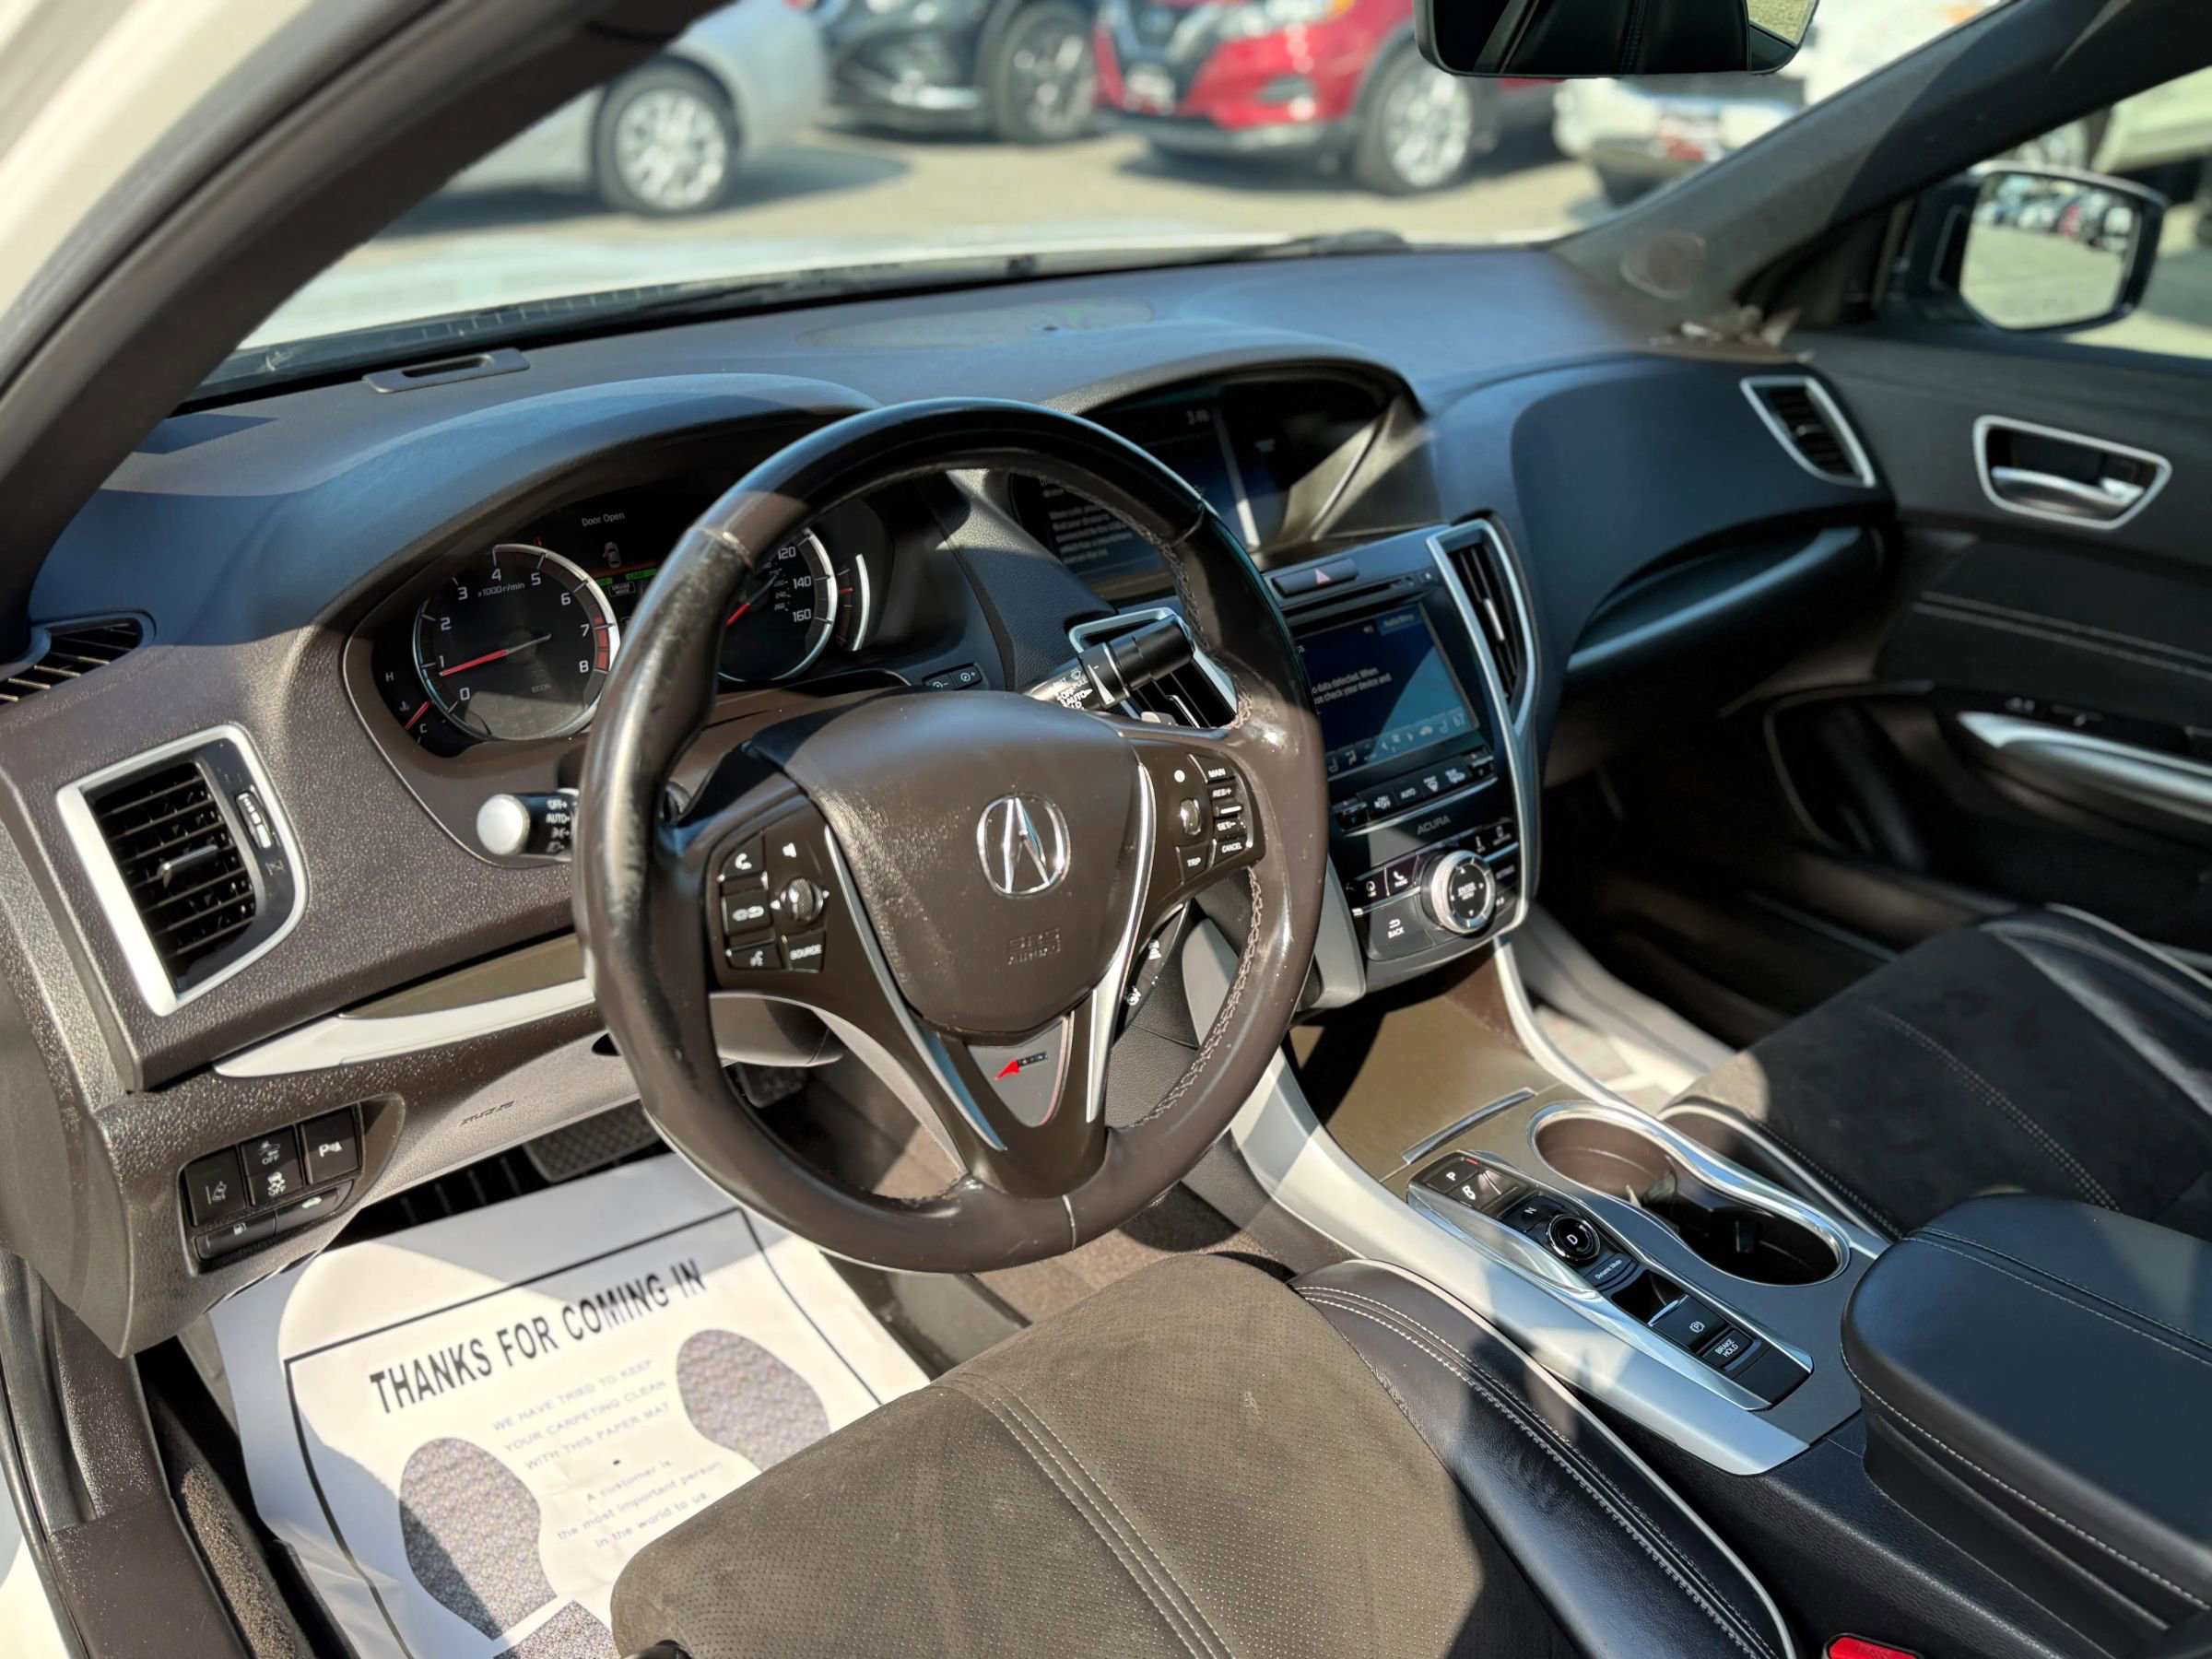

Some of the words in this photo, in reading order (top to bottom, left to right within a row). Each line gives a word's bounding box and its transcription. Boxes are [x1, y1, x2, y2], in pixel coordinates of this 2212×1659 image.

[582, 517, 601, 526] Door
[603, 512, 625, 523] Open
[778, 546, 796, 560] 120
[491, 568, 501, 581] 4
[531, 572, 541, 585] 5
[793, 575, 811, 589] 140
[457, 586, 467, 600] 3
[560, 593, 571, 606] 6
[793, 608, 812, 623] 160
[440, 617, 452, 630] 2
[580, 623, 590, 637] 7
[439, 655, 444, 668] 1
[579, 660, 588, 673] 8
[385, 671, 394, 682] H
[459, 687, 470, 700] 0
[1066, 691, 1087, 706] AUTO
[419, 724, 428, 734] C
[1207, 768, 1227, 778] MAIN
[1400, 787, 1416, 800] AUTO
[547, 798, 562, 810] OFF
[546, 813, 567, 824] AUTO
[1417, 815, 1451, 835] ACURA
[1221, 842, 1242, 853] CANCEL
[1388, 926, 1405, 938] BACK
[789, 944, 822, 960] SOURCE
[262, 1154, 279, 1166] OFF
[1445, 1171, 1456, 1182] P
[1524, 1206, 1537, 1215] N
[1566, 1234, 1578, 1245] D
[1594, 1266, 1612, 1279] Dynamic
[1611, 1259, 1622, 1271] Mode
[370, 1338, 492, 1413] THANKS
[496, 1316, 559, 1367] FOR
[562, 1273, 669, 1340] COMING
[670, 1258, 706, 1298] IN
[1714, 1338, 1735, 1355] BRAKE
[1722, 1343, 1739, 1358] HOLD
[492, 1417, 514, 1431] WE
[518, 1399, 554, 1421] HAVE
[558, 1382, 596, 1405] TRIED
[599, 1374, 618, 1386] TO
[620, 1359, 653, 1378] KEEP
[505, 1430, 543, 1453] YOUR
[546, 1398, 620, 1435] CARPETING
[623, 1380, 666, 1403] CLEAN
[524, 1450, 560, 1471] WITH
[596, 1415, 641, 1440] PAPER
[642, 1400, 670, 1420] MAT
[586, 1493, 597, 1503] A
[600, 1466, 657, 1497] customer
[557, 1526, 579, 1541] the
[582, 1508, 614, 1530] most
[616, 1480, 677, 1512] important
[680, 1461, 722, 1486] person
[611, 1526, 632, 1541] the
[637, 1507, 672, 1528] world
[675, 1500, 688, 1512] to
